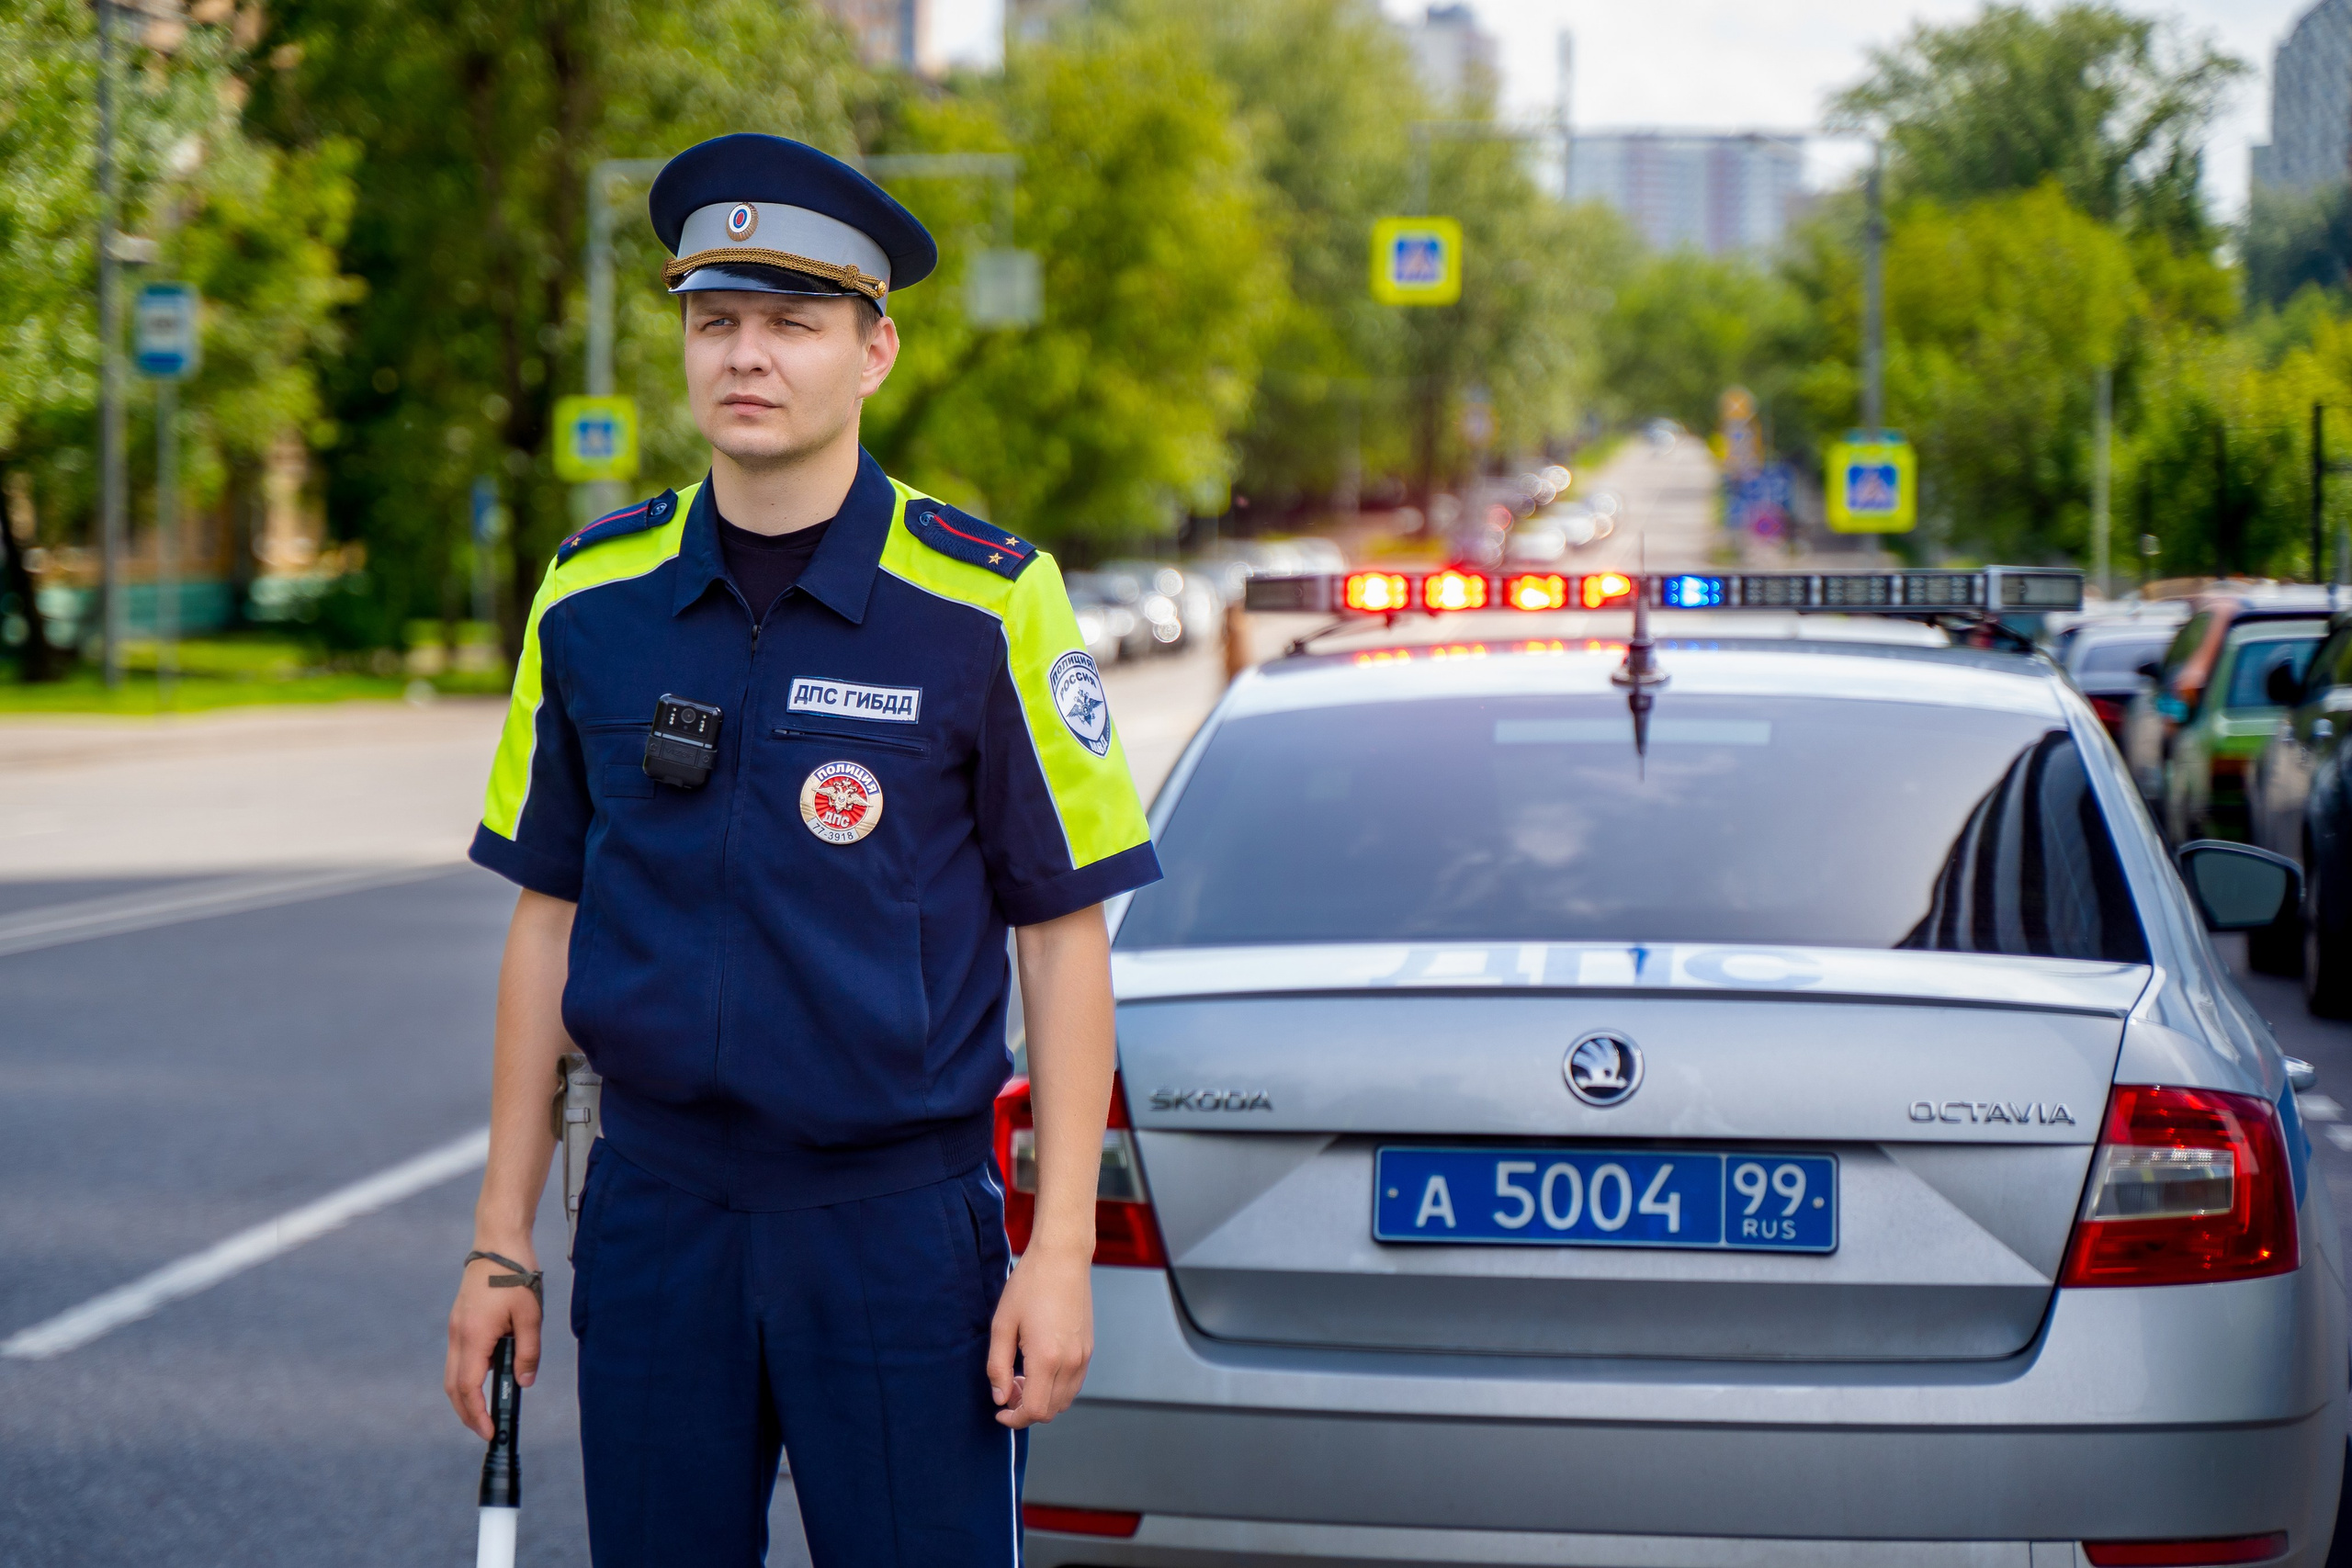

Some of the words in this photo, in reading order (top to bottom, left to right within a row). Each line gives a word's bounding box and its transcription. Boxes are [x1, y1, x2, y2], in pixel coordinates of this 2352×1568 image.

[1052, 655, 1095, 685] ПОЛИЦИЯ
[793, 684, 838, 705] ДПС
[843, 690, 913, 716] ГИБДД
[1059, 671, 1097, 702] РОССИЯ
[1088, 734, 1108, 755] МВД
[817, 763, 877, 794] ПОЛИЦИЯ
[812, 822, 854, 841] 77-3918
[822, 811, 850, 828] ДПС
[1369, 946, 1825, 988] ДПС
[1910, 1100, 2076, 1125] OCTAVIA
[1416, 1175, 1457, 1229] А
[1493, 1161, 1681, 1234] 5004
[1733, 1163, 1807, 1217] 99
[1742, 1219, 1797, 1240] RUS
